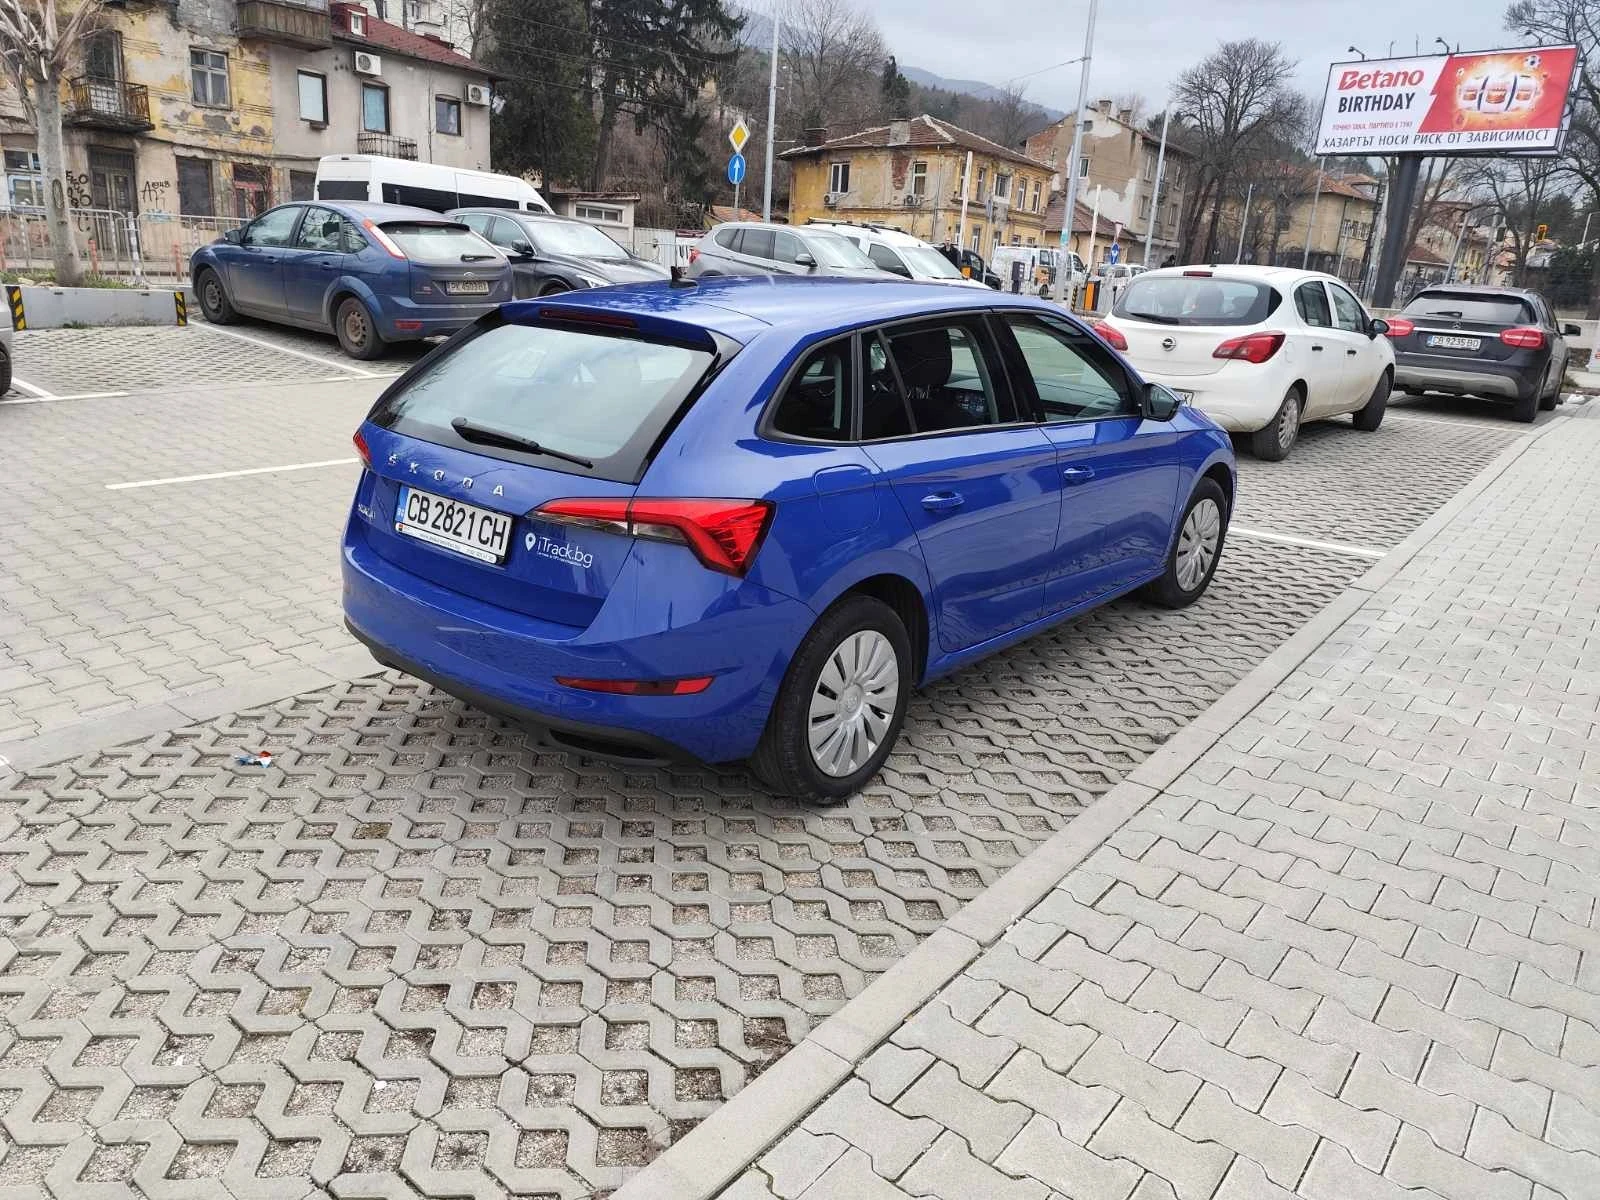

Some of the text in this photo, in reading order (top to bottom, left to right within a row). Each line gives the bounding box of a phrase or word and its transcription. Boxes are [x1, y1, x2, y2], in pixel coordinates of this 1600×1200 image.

[1338, 70, 1424, 91] Betano
[1338, 93, 1416, 113] BIRTHDAY
[1323, 129, 1551, 148] ХАЗАРТЪТ НОСИ РИСК ОТ ЗАВИСИМОСТ
[407, 493, 431, 525] CB
[431, 501, 476, 541] 2821
[478, 514, 507, 550] CH
[537, 536, 593, 568] iTrack.bg
